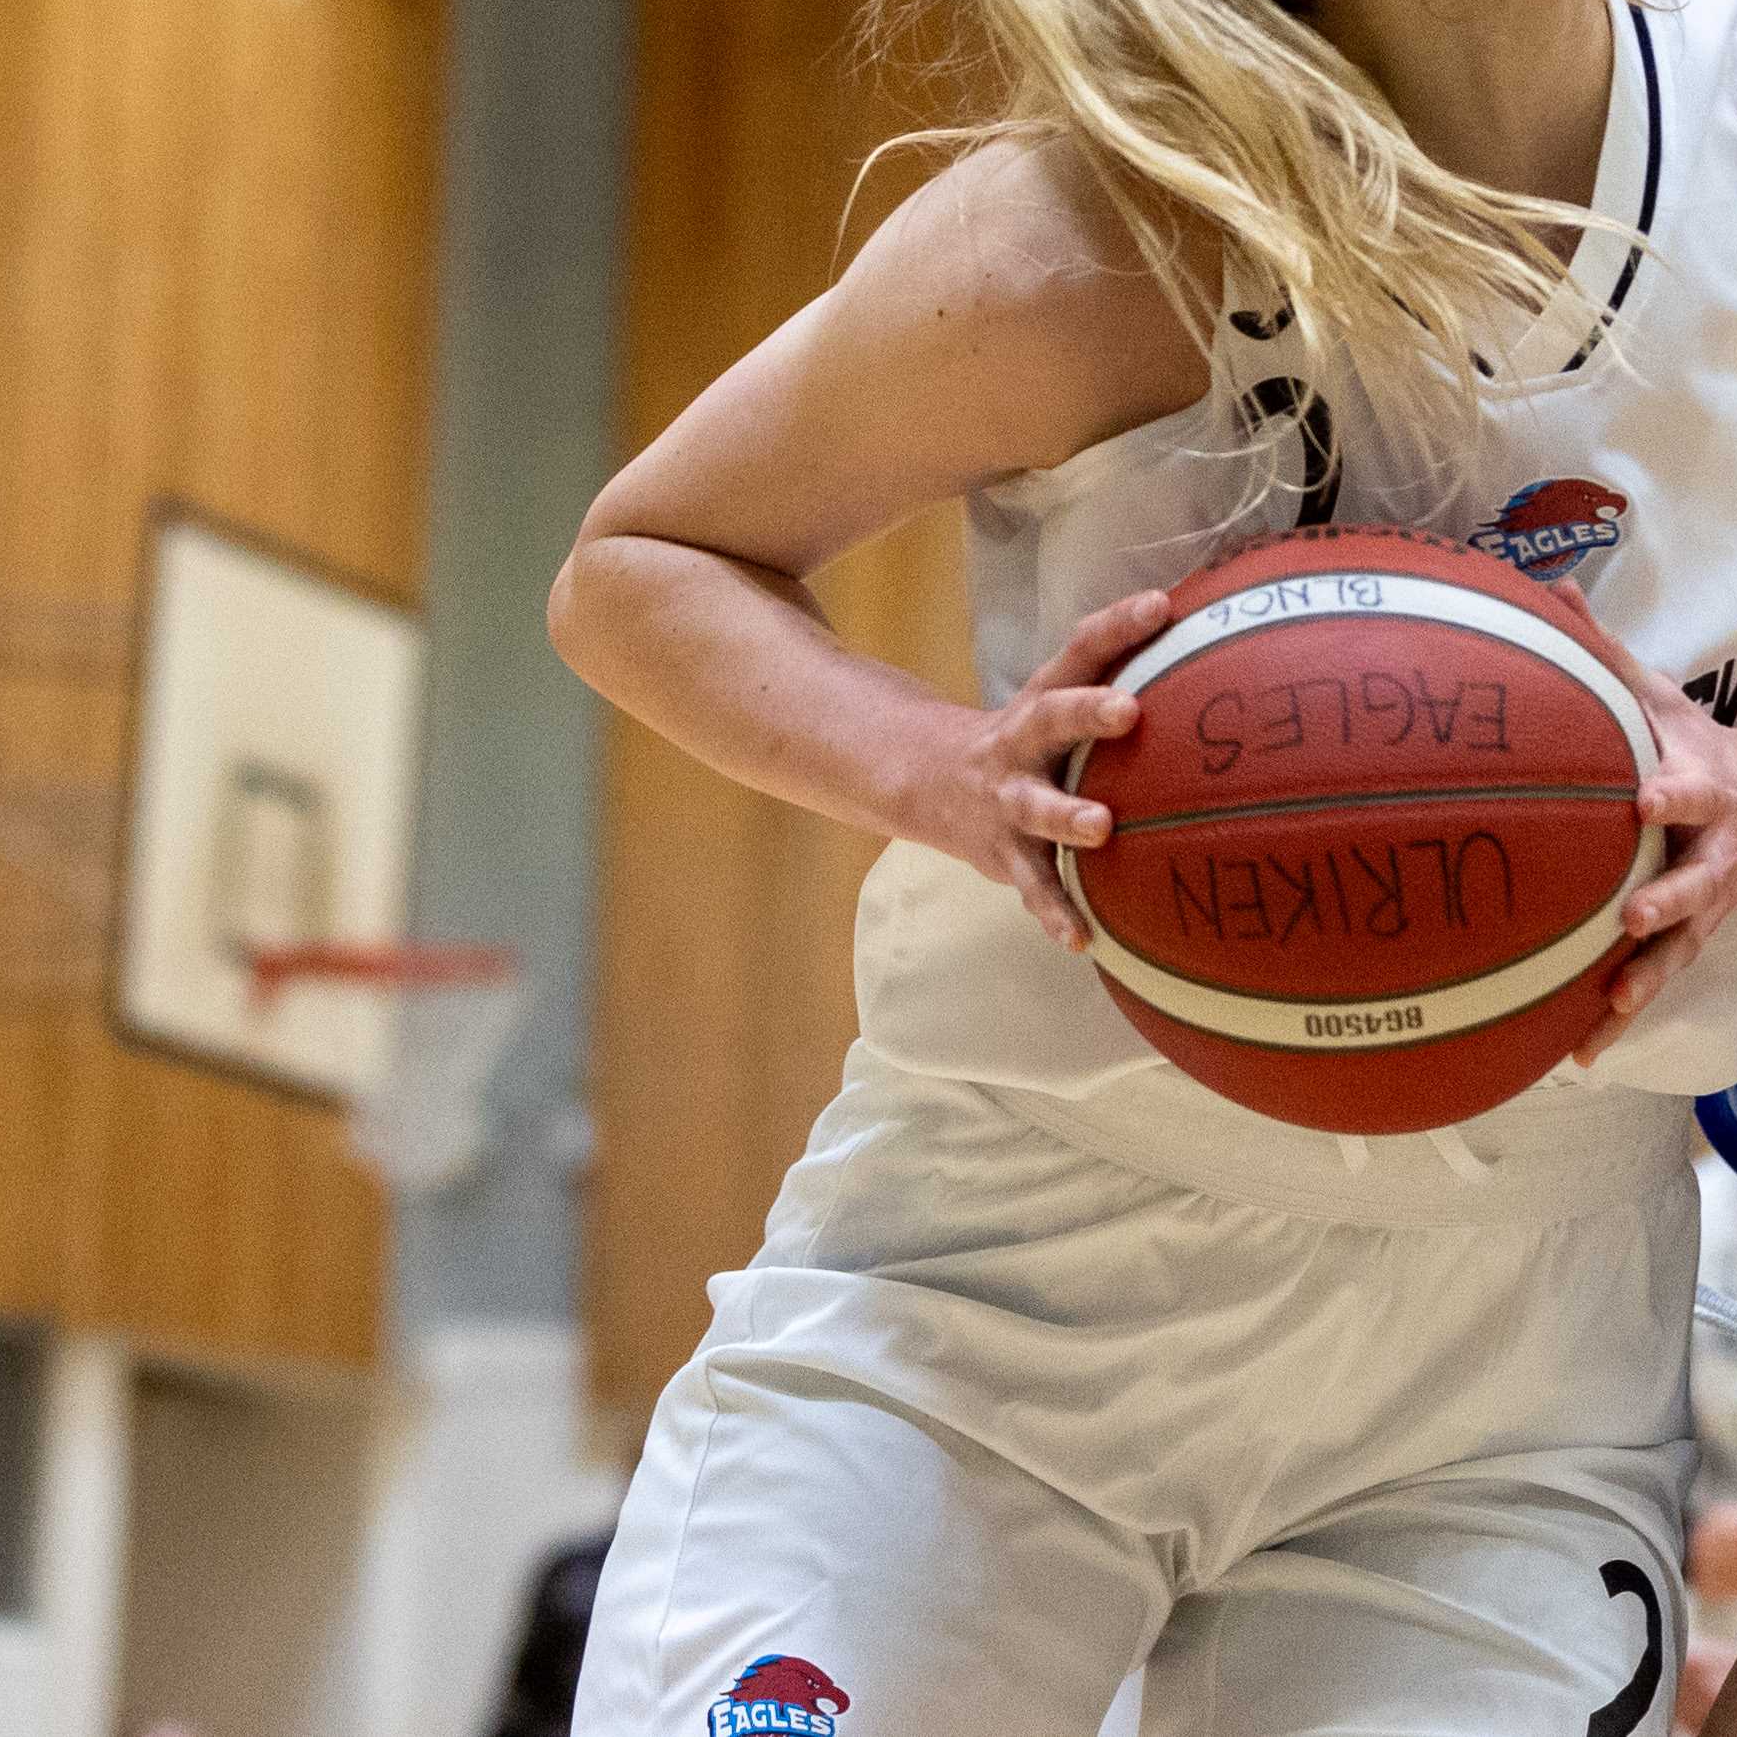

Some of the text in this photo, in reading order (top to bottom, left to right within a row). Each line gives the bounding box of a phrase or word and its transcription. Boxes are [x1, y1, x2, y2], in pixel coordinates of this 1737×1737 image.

[1475, 521, 1617, 565] EAGLES
[1195, 668, 1512, 778] EAGLES
[1165, 828, 1515, 950] ULRIKEN
[1304, 1005, 1424, 1040] BG4500
[712, 1700, 833, 1737] EAGLES
